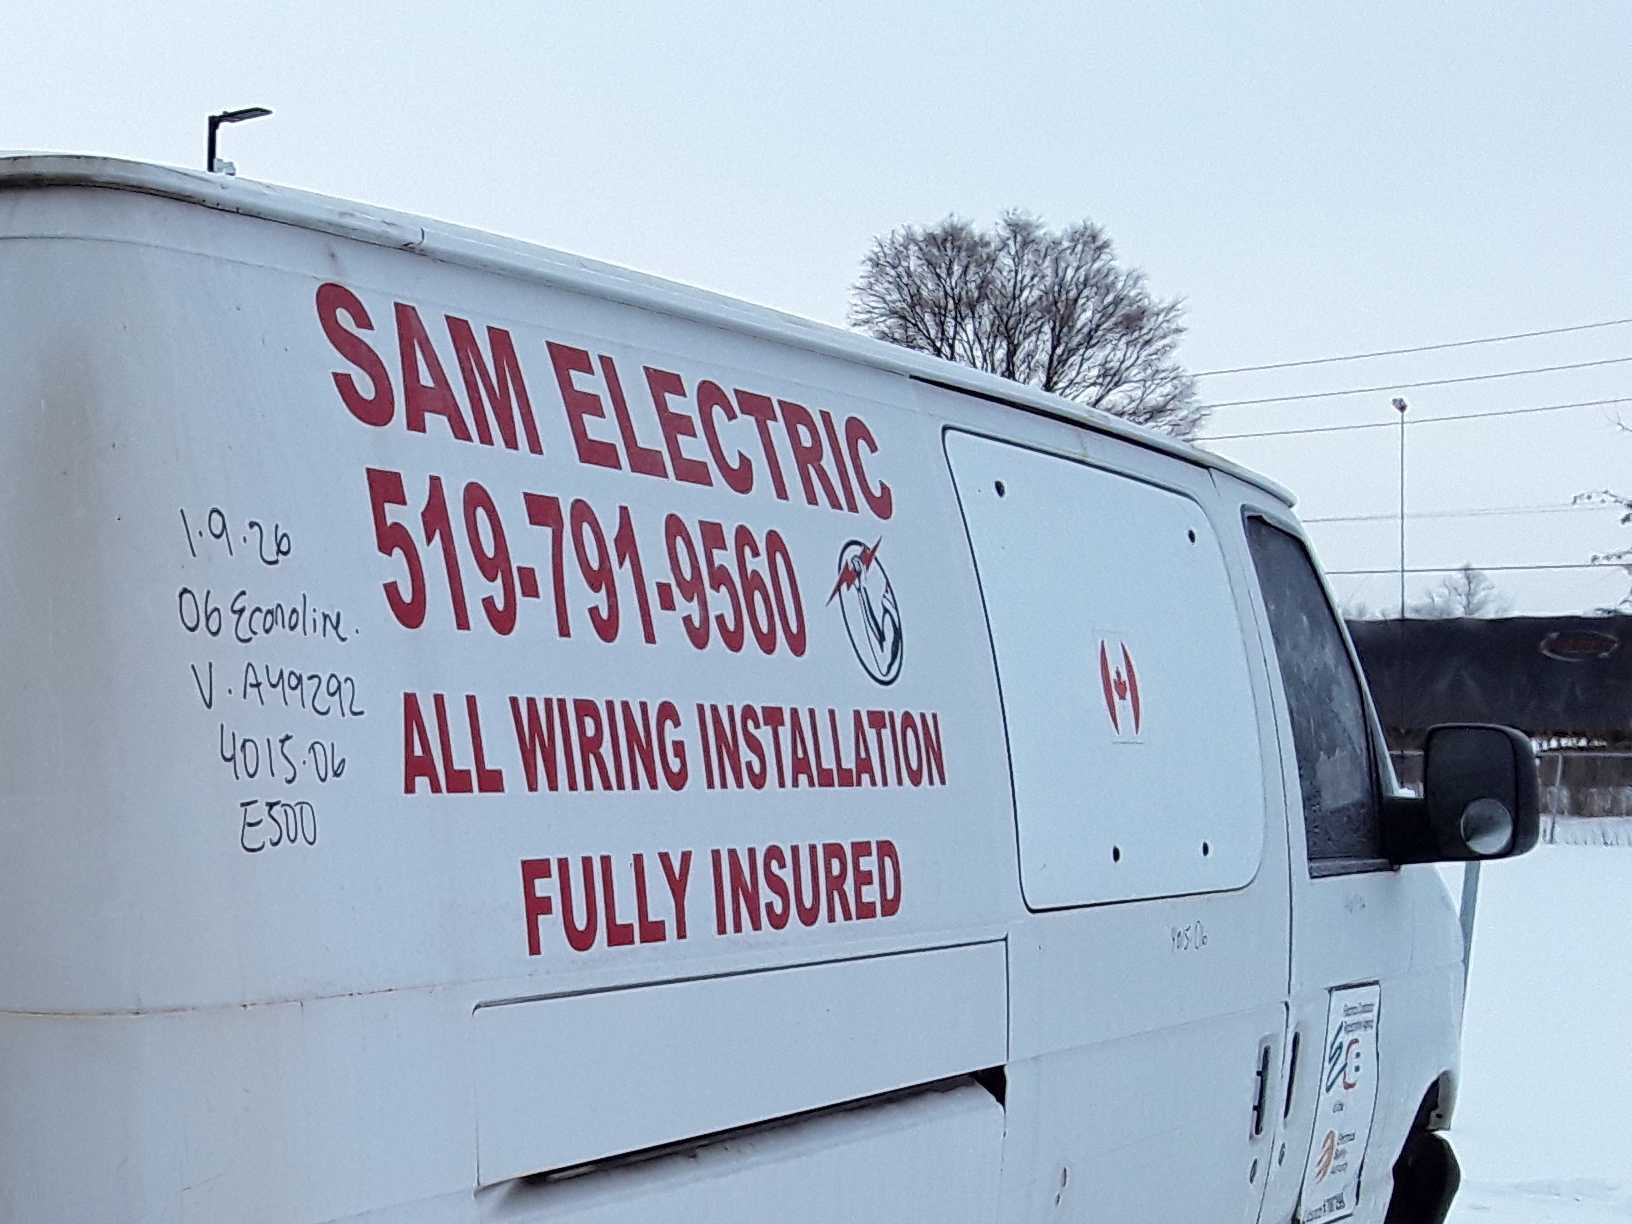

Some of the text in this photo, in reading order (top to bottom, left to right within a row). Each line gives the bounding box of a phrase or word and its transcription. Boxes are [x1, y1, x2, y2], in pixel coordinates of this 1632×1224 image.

[316, 282, 893, 520] SAM ELECTRIC
[367, 468, 806, 657] 519-791-9560
[403, 693, 946, 795] ALL WIRING INSTALLATION
[521, 840, 901, 956] FULLY INSURED
